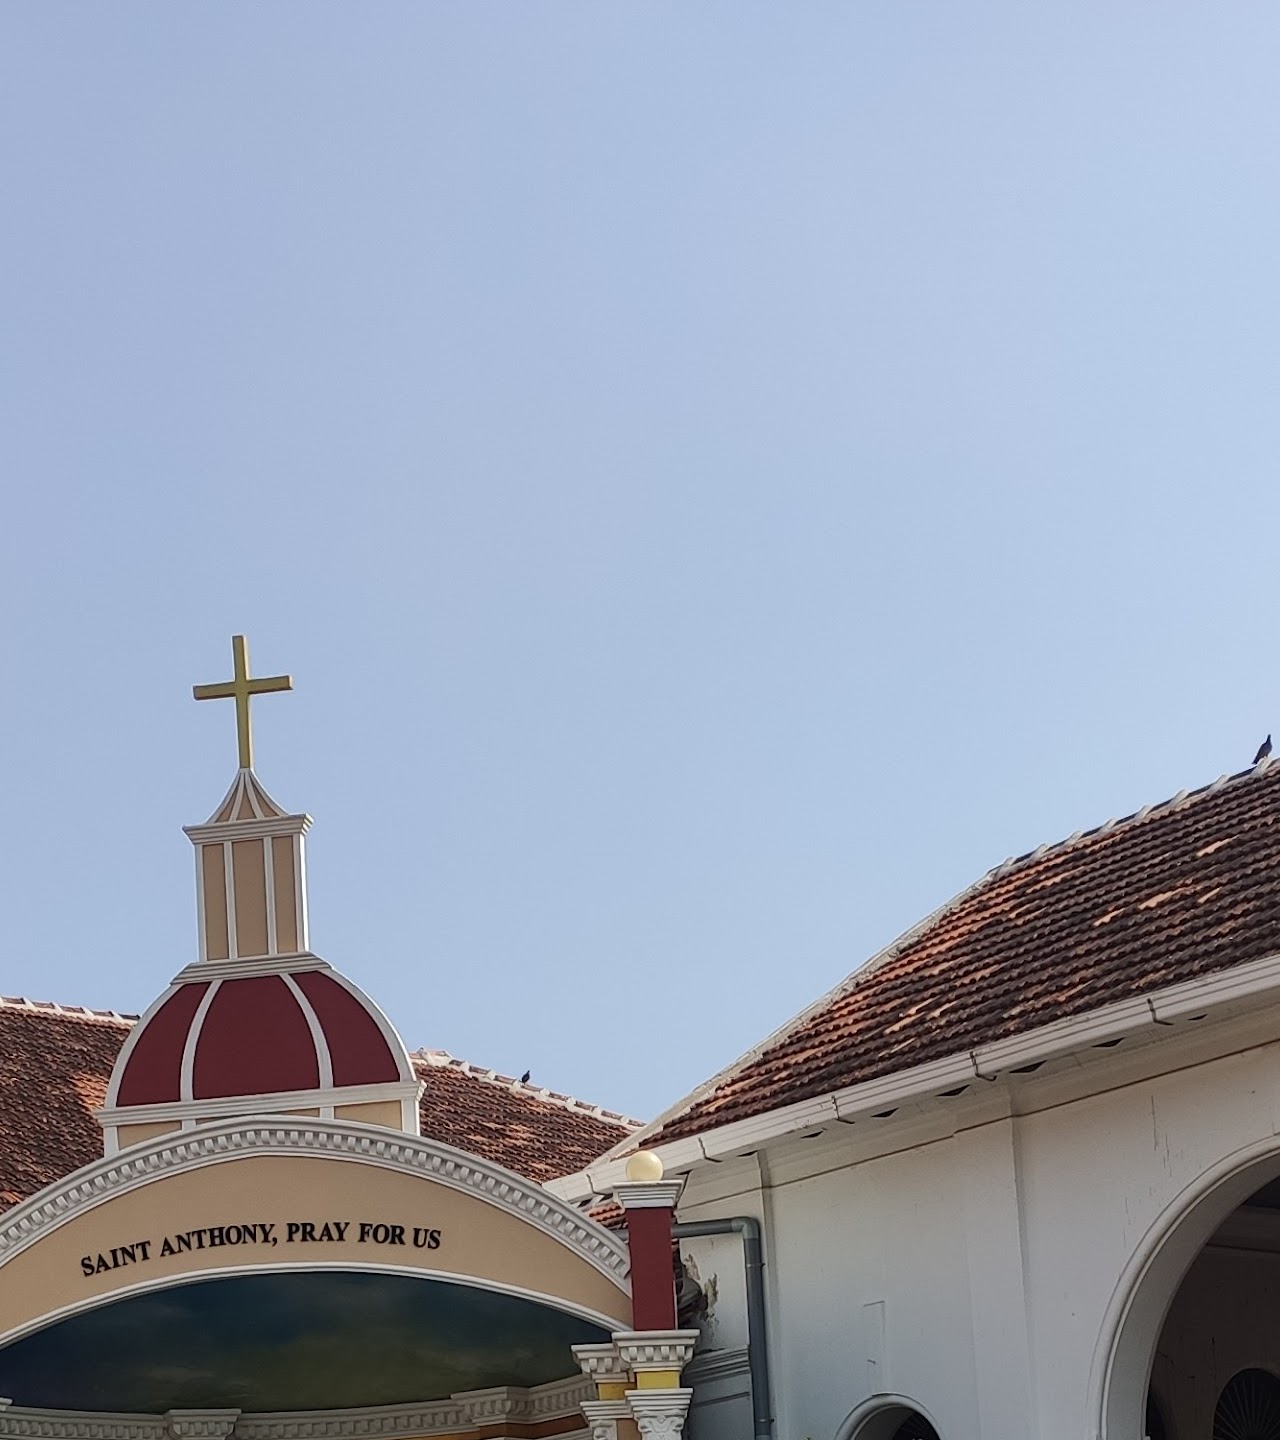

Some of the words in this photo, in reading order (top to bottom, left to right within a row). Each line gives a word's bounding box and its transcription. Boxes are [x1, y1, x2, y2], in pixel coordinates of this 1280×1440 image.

[80, 1240, 152, 1277] SAINT
[160, 1223, 278, 1257] ANTHONY,
[286, 1221, 350, 1243] PRAY
[358, 1223, 406, 1245] FOR
[412, 1227, 442, 1250] US
